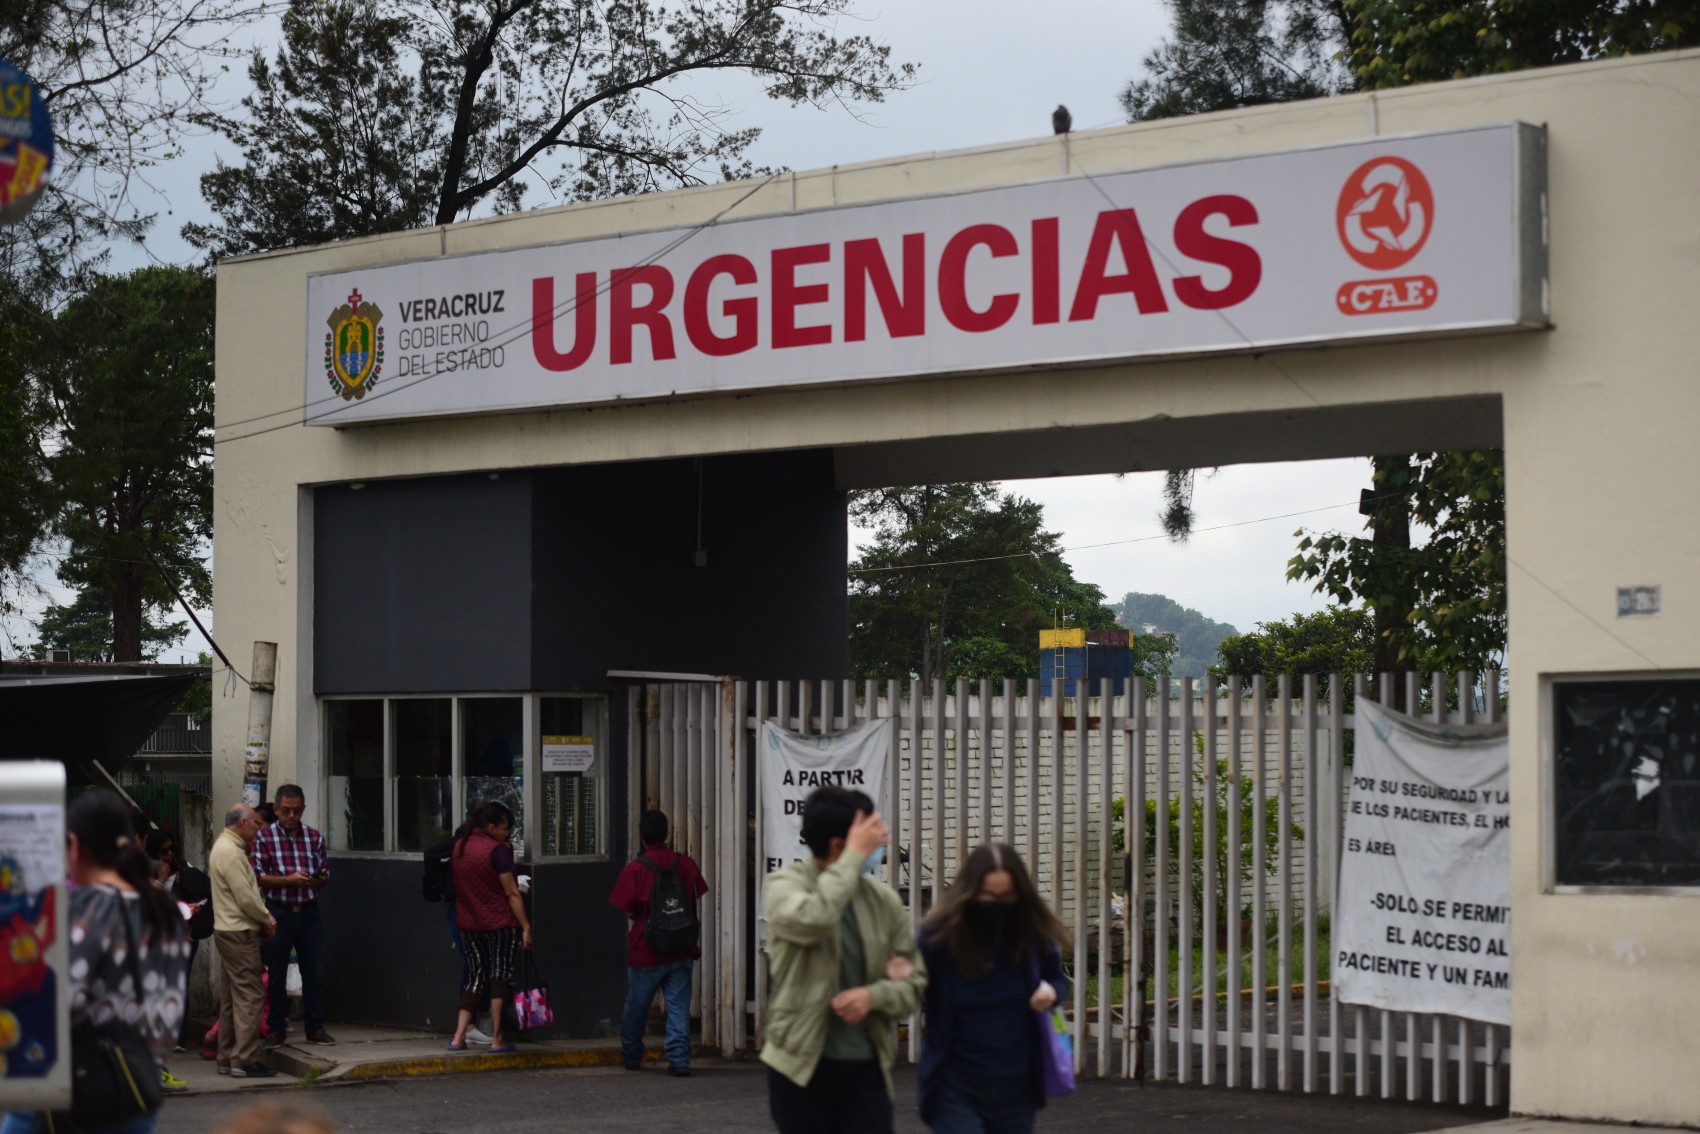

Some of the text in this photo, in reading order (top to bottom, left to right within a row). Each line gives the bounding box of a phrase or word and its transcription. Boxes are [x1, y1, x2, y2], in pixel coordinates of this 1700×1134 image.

[532, 195, 1263, 373] URGENCIAS
[1350, 281, 1424, 311] CAE
[399, 290, 505, 324] VERACRUZ
[399, 320, 489, 351] GOBIERNO
[398, 346, 505, 377] DEL ESTADO
[783, 769, 864, 787] A PARTIR
[1380, 780, 1398, 794] SU
[1402, 782, 1478, 804] SEGURIDAD
[1483, 790, 1491, 804] Y
[1394, 806, 1469, 829] PACIENTES,
[1475, 814, 1488, 828] EL
[1348, 838, 1361, 852] ES
[1370, 892, 1418, 914] -SOLO
[1422, 900, 1446, 918] SE
[1386, 926, 1508, 956] EL ACCESO AL
[1338, 951, 1421, 978] PACIENTE
[1426, 964, 1438, 980] Y
[1443, 966, 1467, 985] UN
